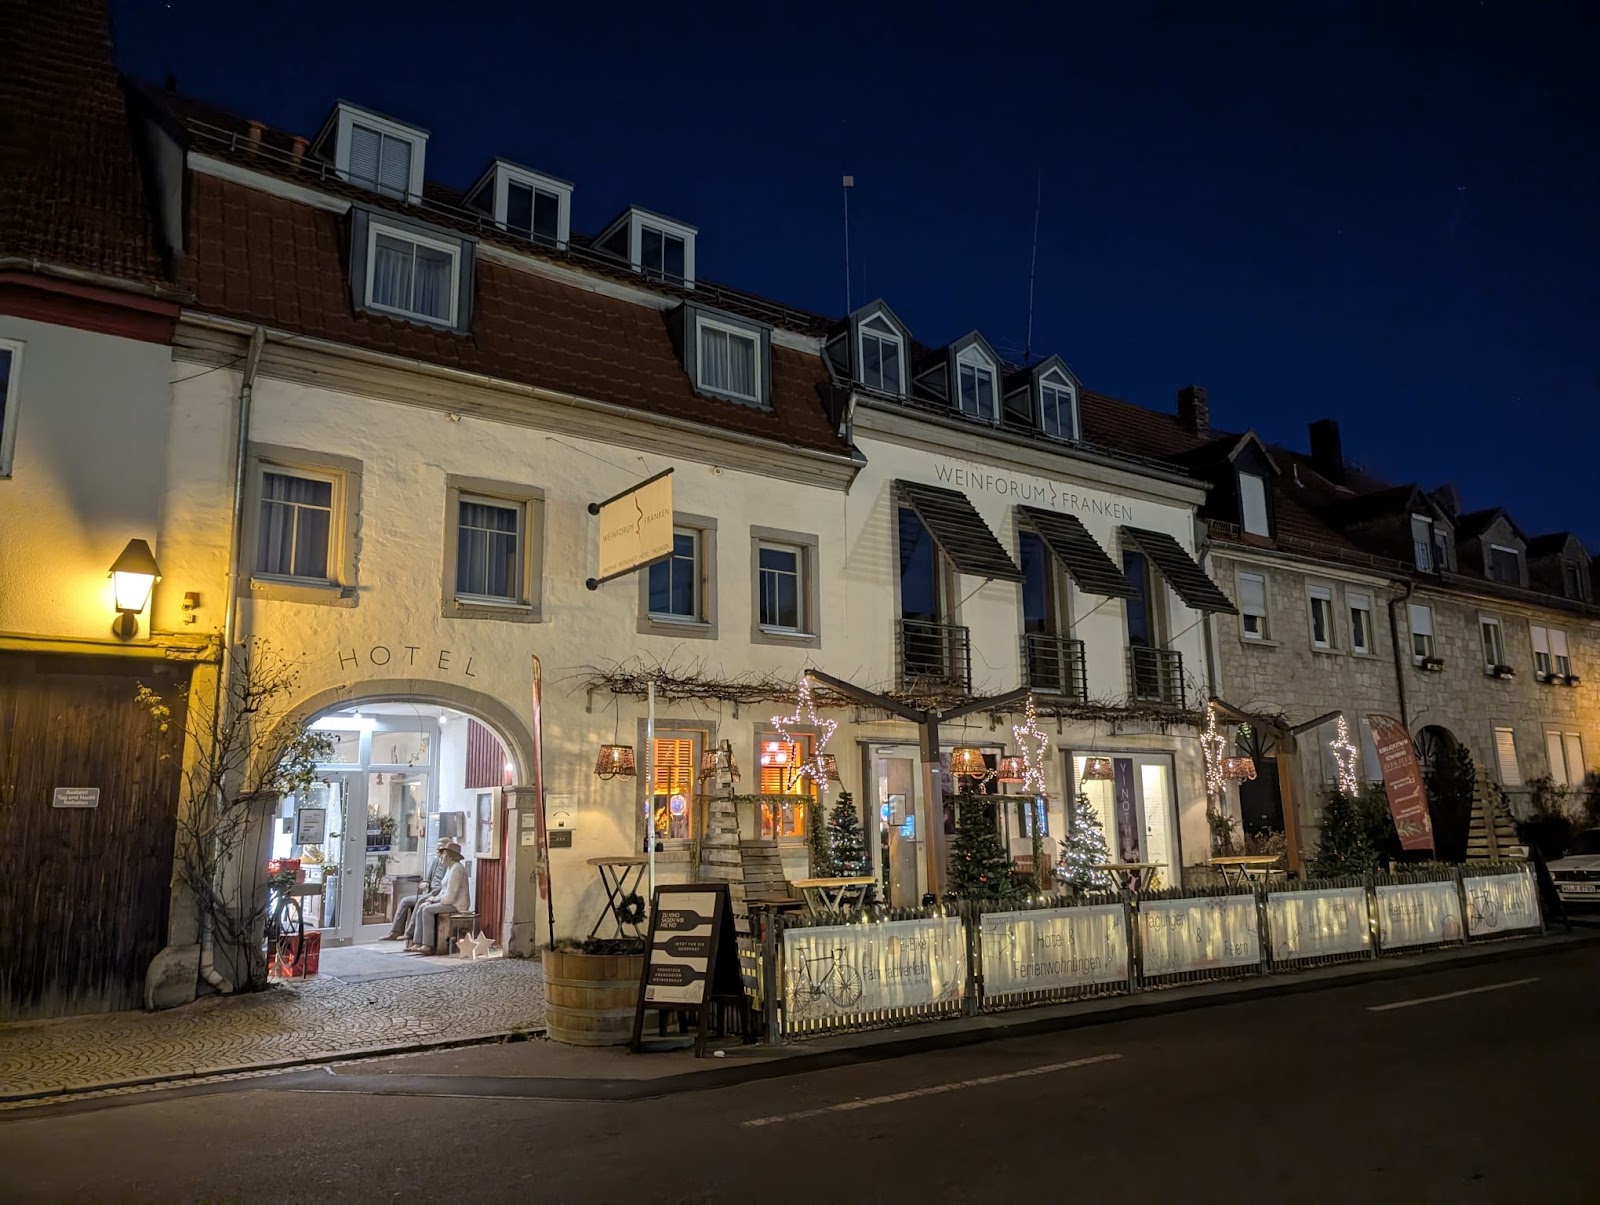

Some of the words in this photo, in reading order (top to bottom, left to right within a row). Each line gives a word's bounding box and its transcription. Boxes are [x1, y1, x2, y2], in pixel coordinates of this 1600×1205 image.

[935, 464, 1046, 503] WEINFORUM
[1062, 492, 1133, 521] FRANKEN
[603, 523, 635, 542] WEINFORUM
[644, 509, 670, 525] FRANKEN
[338, 646, 476, 677] HOTEL
[1144, 912, 1186, 932] Tagungen
[1038, 931, 1065, 949] Hote
[1068, 928, 1075, 946] &
[1196, 927, 1203, 943] &
[1014, 956, 1102, 978] Ferienwohnungen
